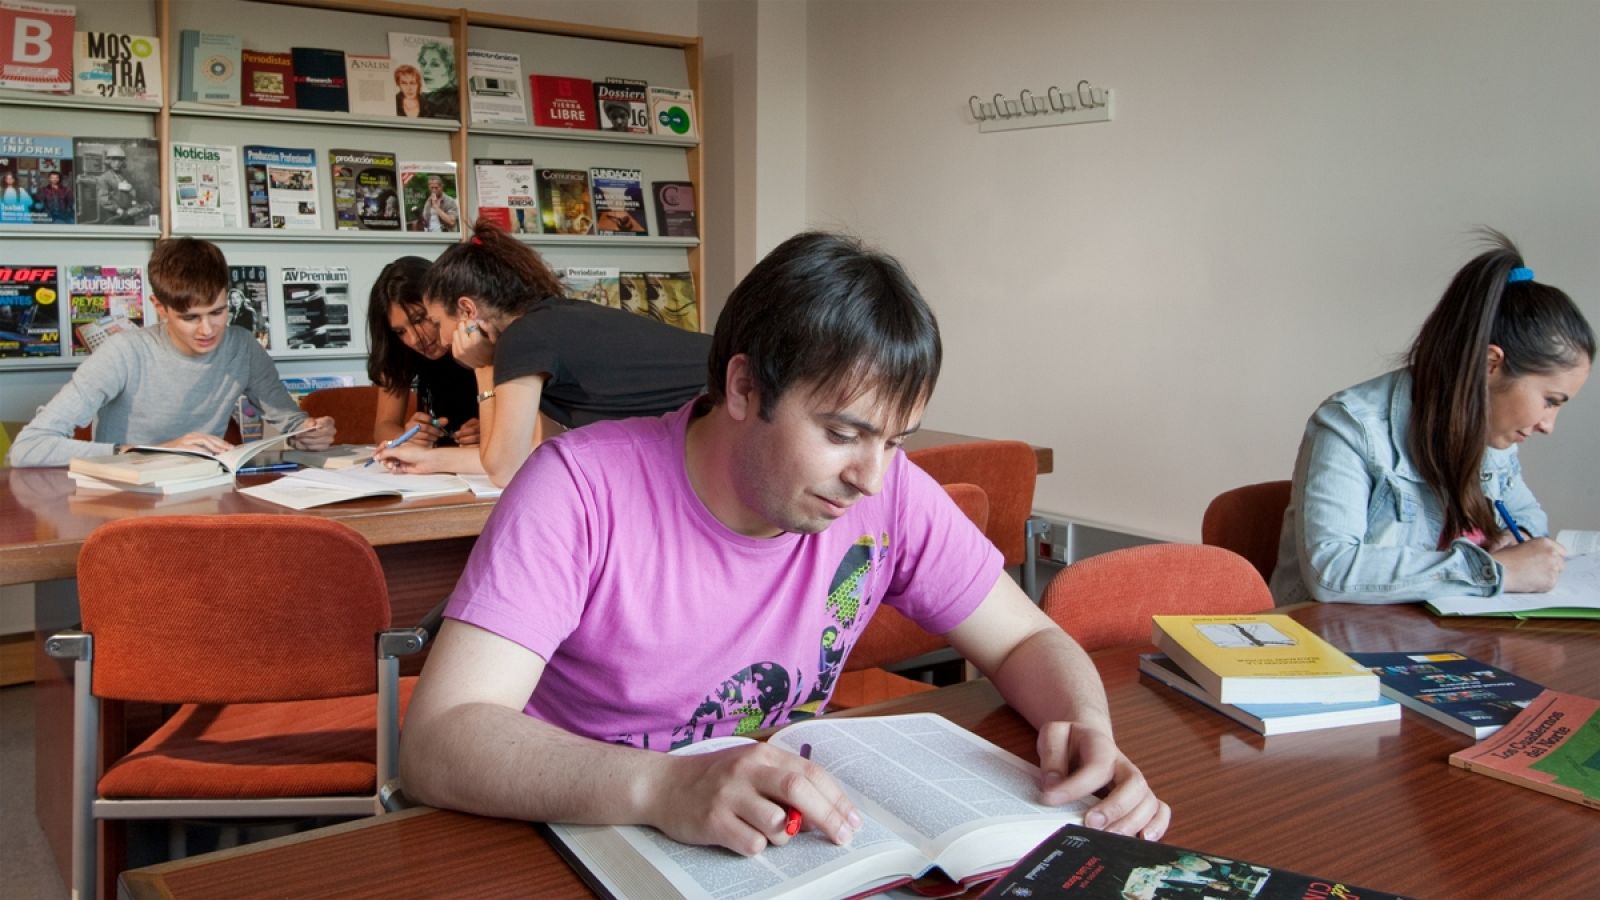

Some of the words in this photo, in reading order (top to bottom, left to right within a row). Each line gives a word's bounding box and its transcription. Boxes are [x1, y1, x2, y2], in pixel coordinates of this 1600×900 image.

[12, 17, 53, 63] B
[88, 32, 132, 60] MOS
[243, 53, 291, 66] Periodistas
[108, 60, 146, 88] TRA
[97, 84, 115, 97] 32
[599, 86, 645, 98] Dossiers
[552, 101, 582, 109] TIERRA
[550, 108, 586, 121] LIBRE
[631, 109, 648, 127] 16
[1, 136, 33, 145] TELE
[2, 144, 63, 154] INFORME
[173, 145, 221, 161] Noticias
[247, 150, 279, 161] Producción
[280, 152, 313, 164] Profesional
[592, 168, 641, 180] FUNDACIÓN
[14, 268, 57, 282] OFF
[284, 271, 299, 281] AV
[300, 271, 348, 281] Premium
[72, 296, 106, 307] REYES
[1491, 747, 1518, 759] Los
[1509, 711, 1566, 750] Cuadernos
[1523, 745, 1548, 759] del
[1536, 726, 1571, 748] Norte
